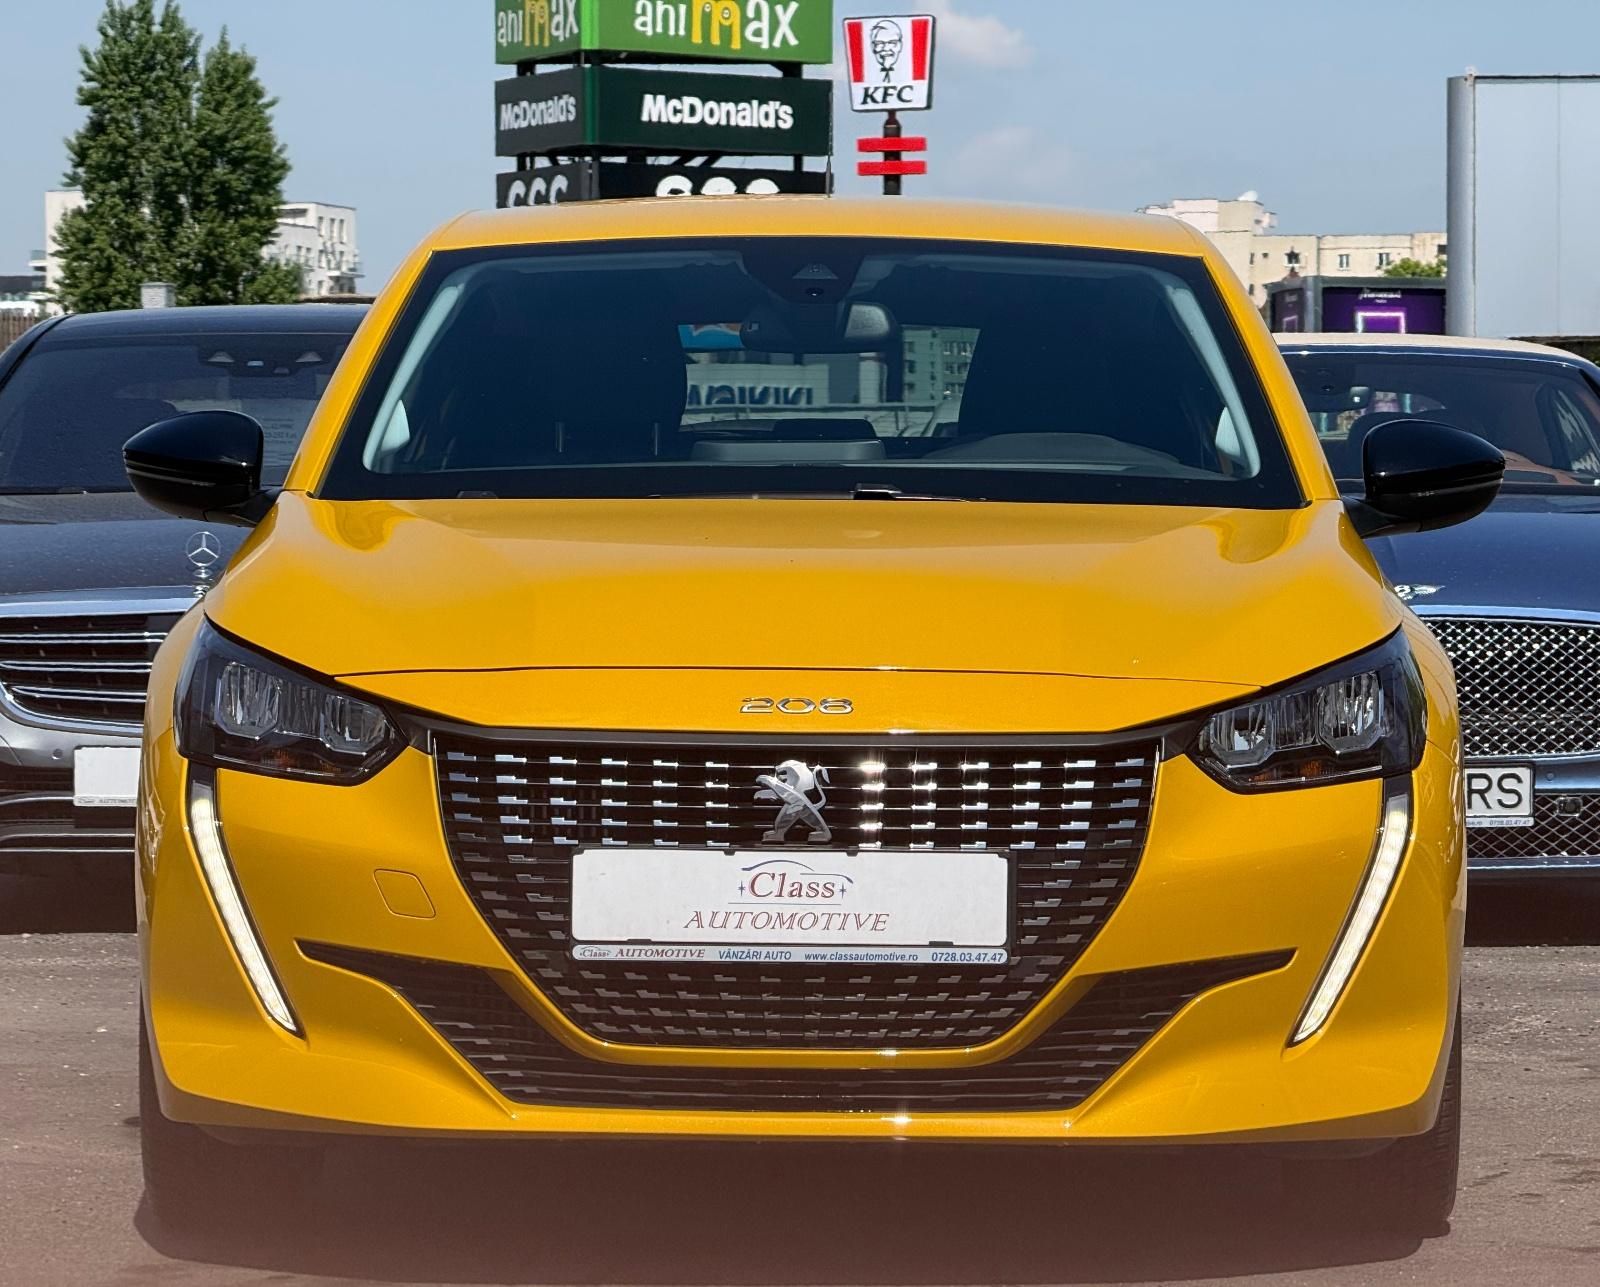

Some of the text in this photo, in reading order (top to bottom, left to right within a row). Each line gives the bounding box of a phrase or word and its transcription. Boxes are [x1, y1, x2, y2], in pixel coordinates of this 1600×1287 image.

[497, 0, 579, 47] animax
[633, 0, 799, 49] animax
[861, 85, 914, 105] KFC
[500, 94, 576, 131] McDonald's
[640, 94, 794, 130] McDonald's
[740, 697, 854, 714] 208
[749, 871, 836, 898] Class
[683, 911, 890, 931] AUTOMOTIVE
[582, 948, 607, 957] Class
[615, 948, 705, 958] AUTOMOTIVE
[764, 950, 792, 960] AUTO
[804, 951, 919, 961] www.classautomotive.ro
[931, 951, 1004, 962] 0728.03.47.47
